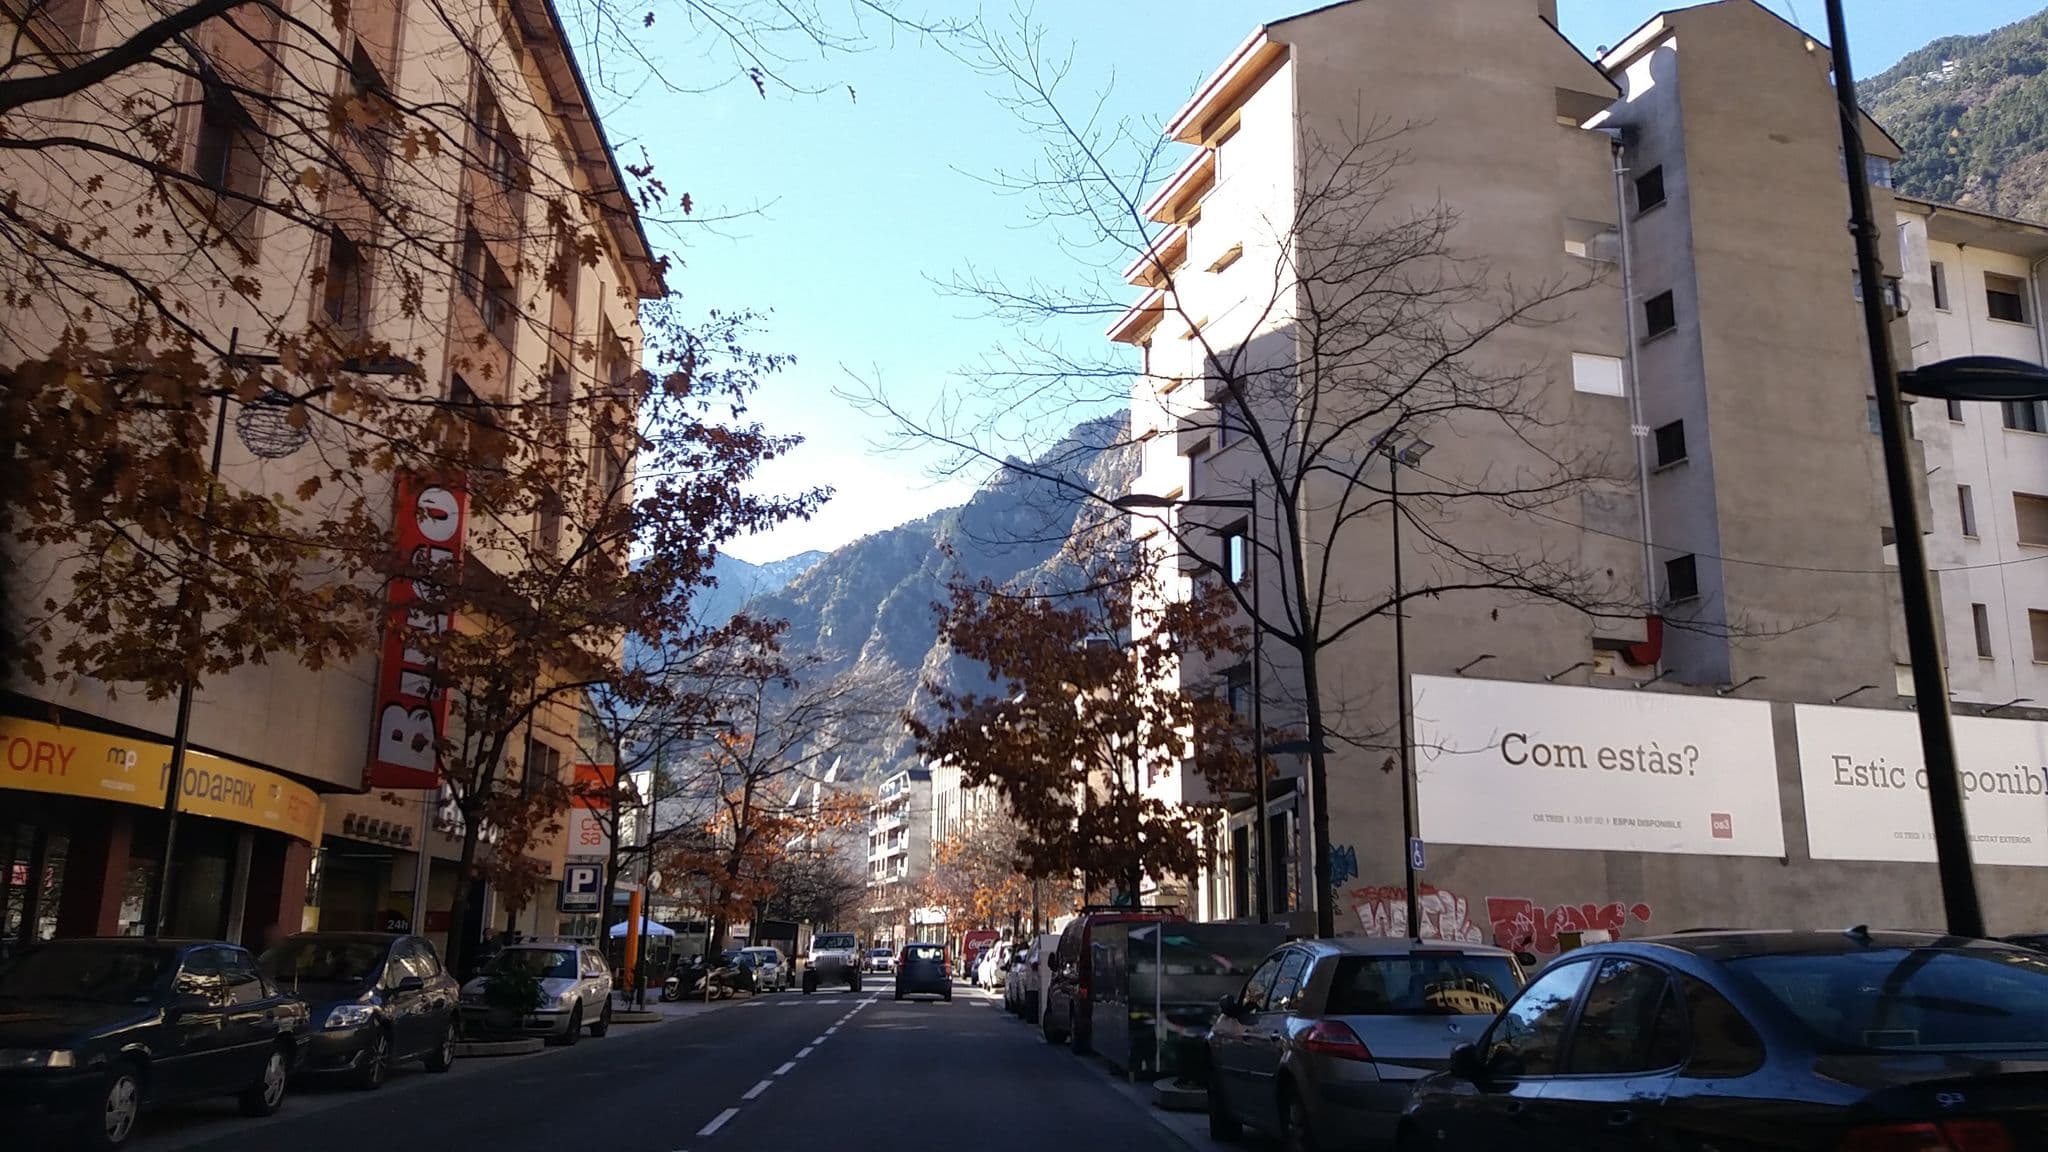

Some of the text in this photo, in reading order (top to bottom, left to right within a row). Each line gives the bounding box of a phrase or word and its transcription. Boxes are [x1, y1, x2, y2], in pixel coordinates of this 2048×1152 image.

[1501, 732, 1700, 776] Com estàs?
[1832, 754, 1906, 789] Estic
[1637, 818, 1681, 829] DISPONIBLE
[571, 868, 594, 893] P
[386, 919, 409, 931] 24h
